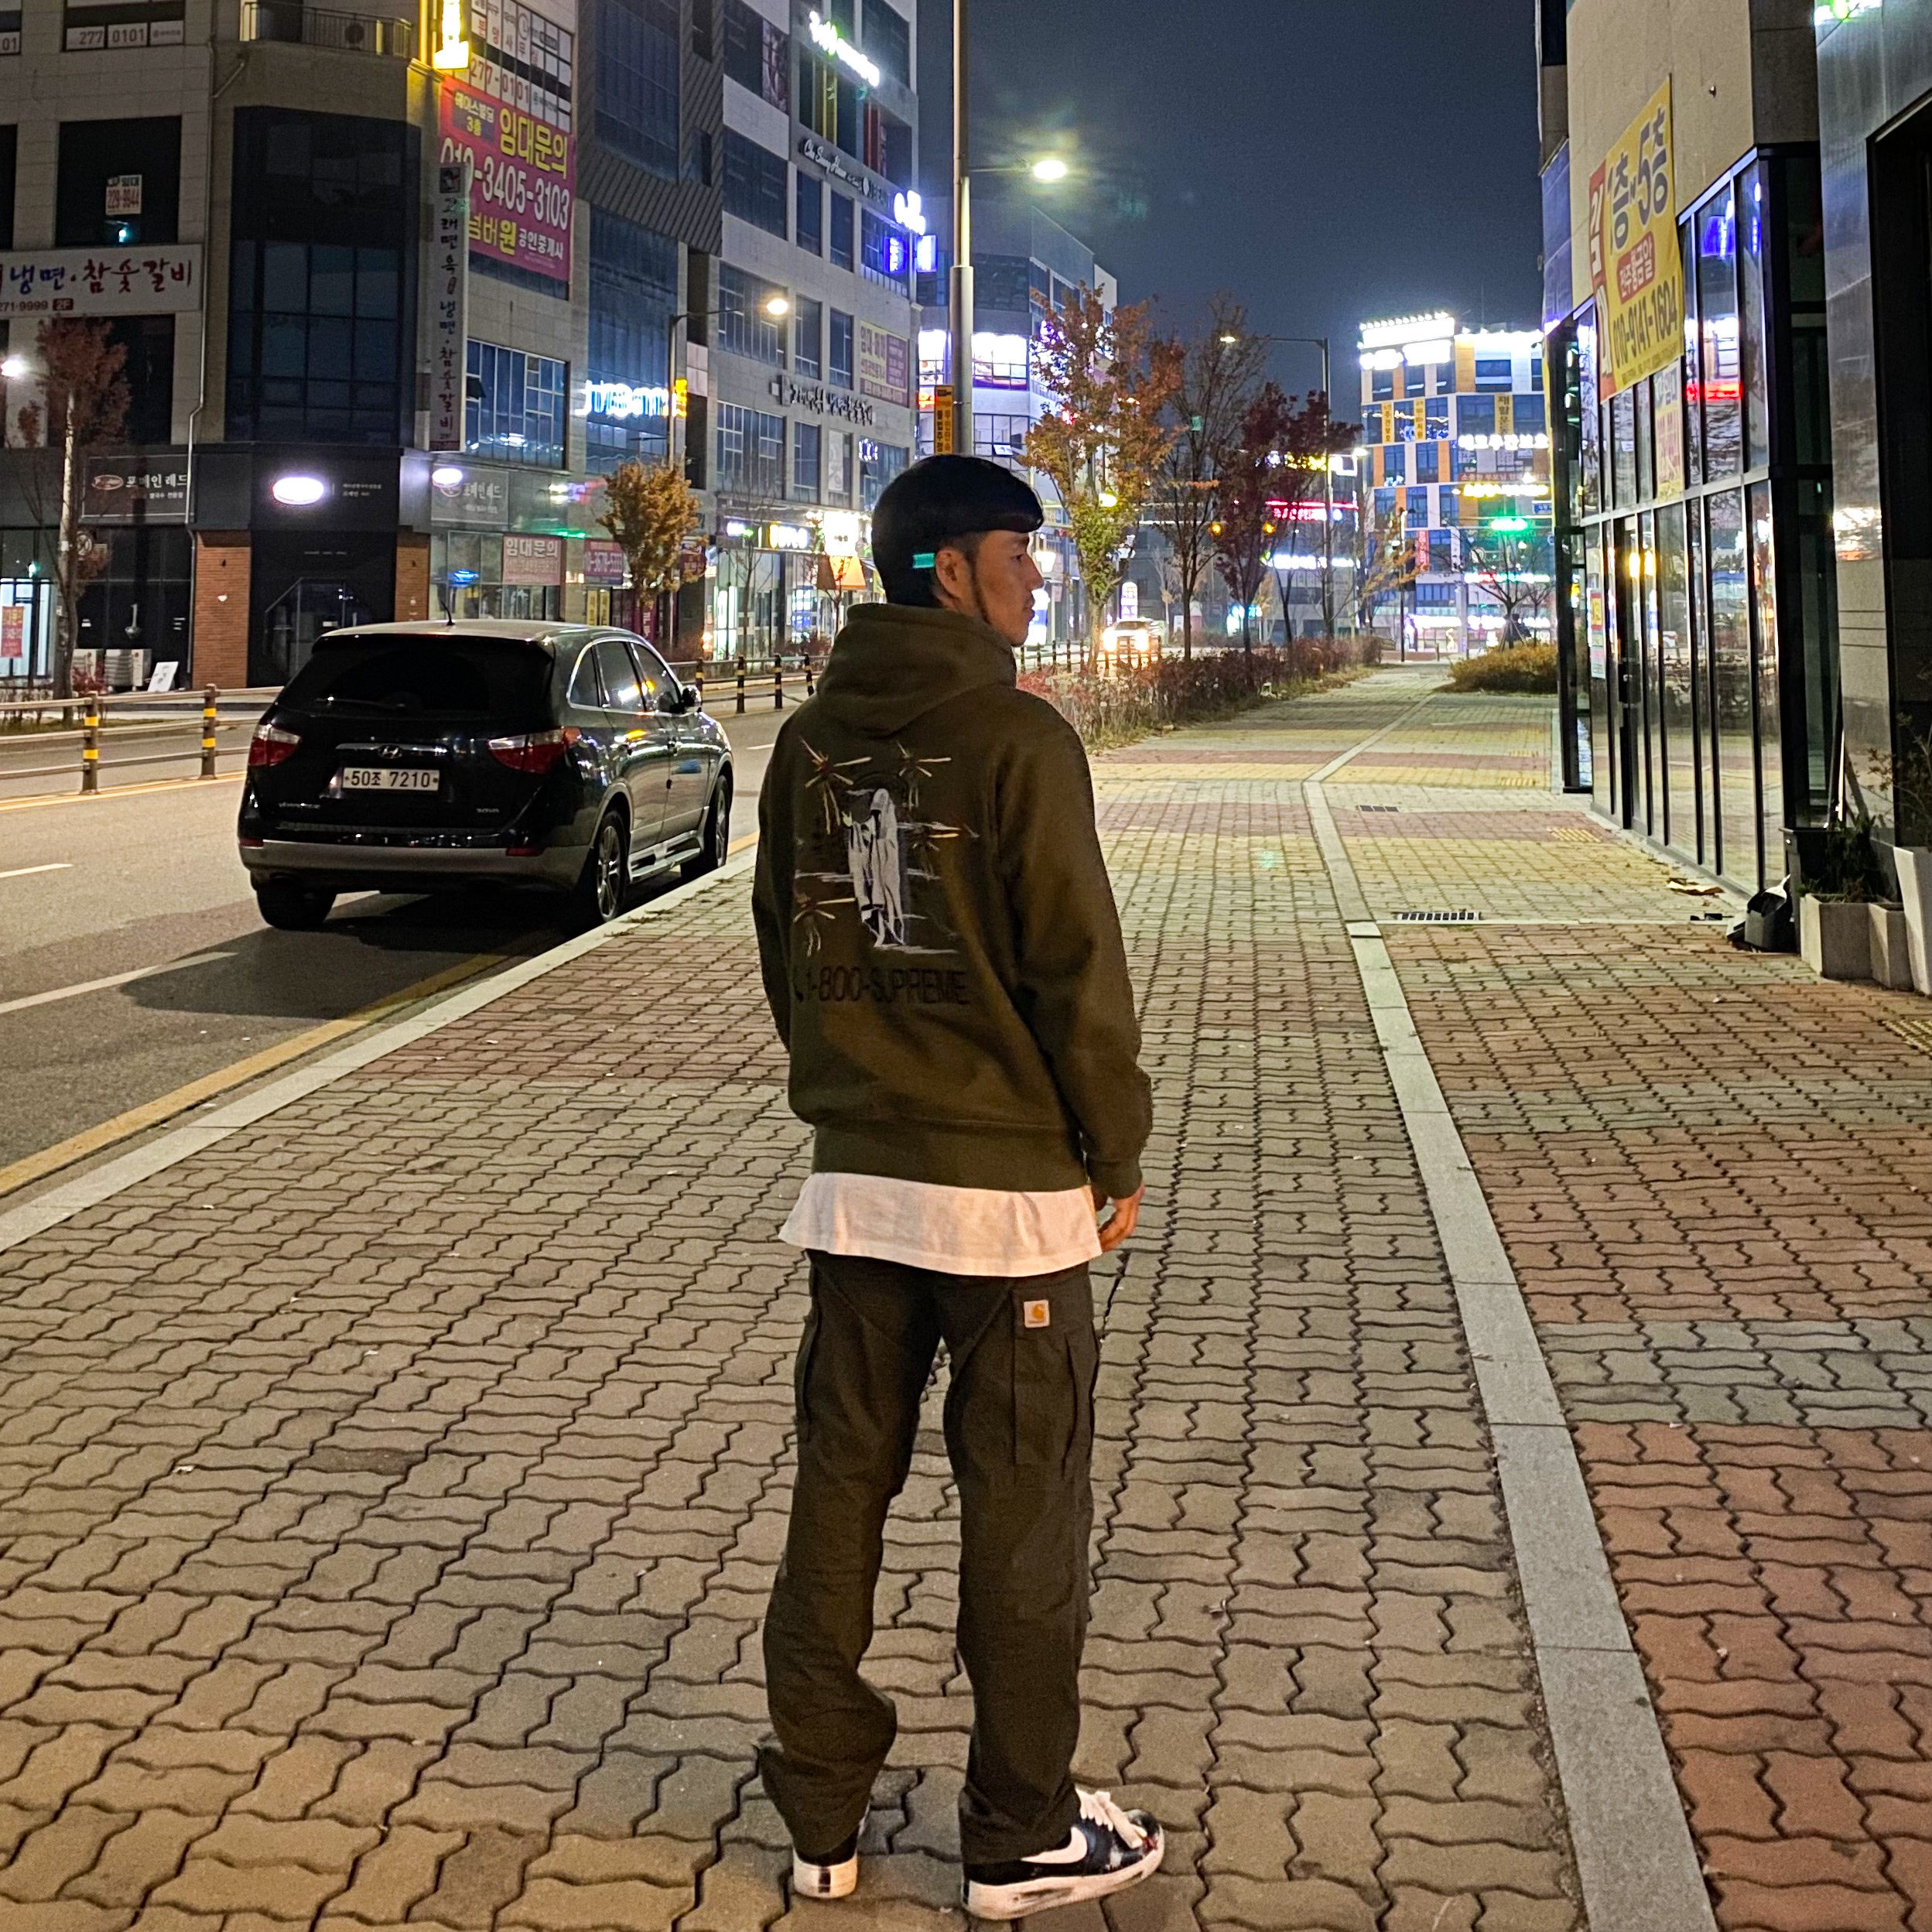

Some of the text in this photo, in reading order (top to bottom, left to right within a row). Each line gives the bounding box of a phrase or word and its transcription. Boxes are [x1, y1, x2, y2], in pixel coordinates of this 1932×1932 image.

[112, 28, 144, 43] 0101
[499, 108, 567, 180] 임대문의
[518, 227, 564, 260] 공인중개사
[506, 538, 558, 557] 임대문의
[350, 771, 430, 787] 50조 7210
